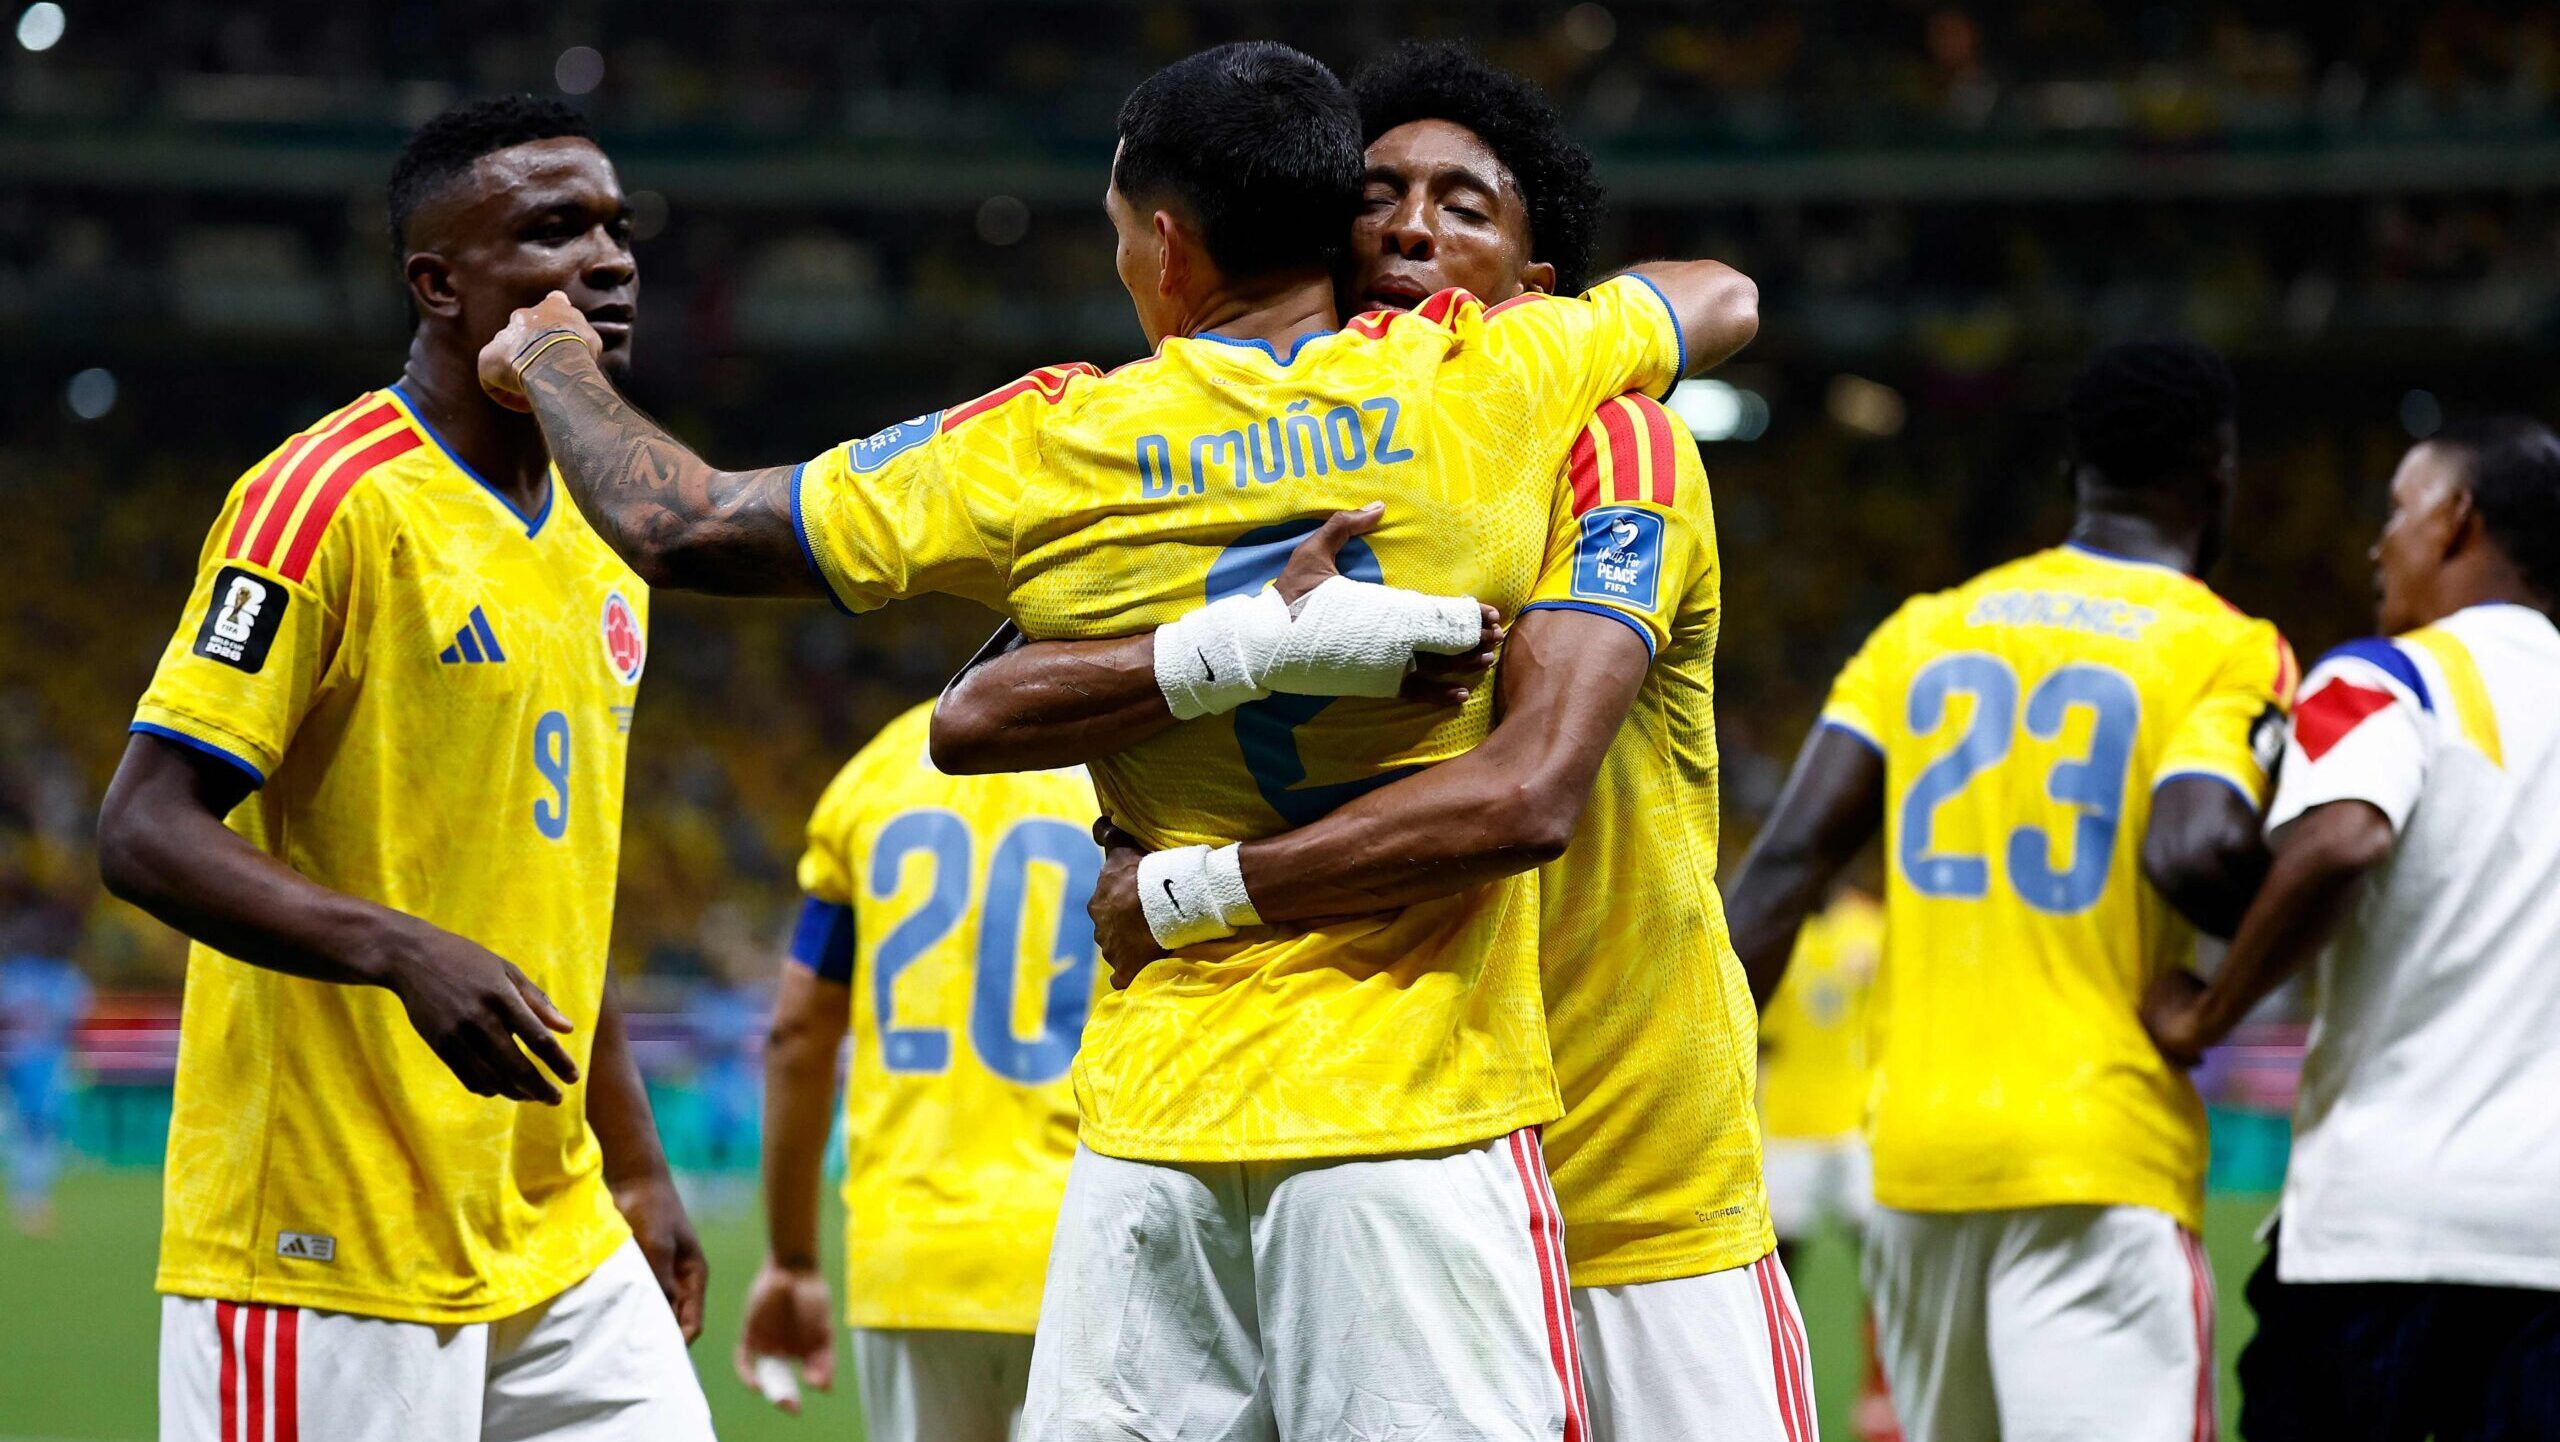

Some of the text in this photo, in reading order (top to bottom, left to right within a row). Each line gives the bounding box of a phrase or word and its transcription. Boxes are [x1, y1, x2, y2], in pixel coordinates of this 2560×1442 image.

[1136, 397, 1414, 498] D.MUÑOZ
[1597, 563, 1637, 585] PEACE
[1604, 582, 1629, 593] FIFA
[533, 710, 570, 840] 9
[1899, 652, 2140, 916] 23
[870, 810, 1102, 1085] 20
